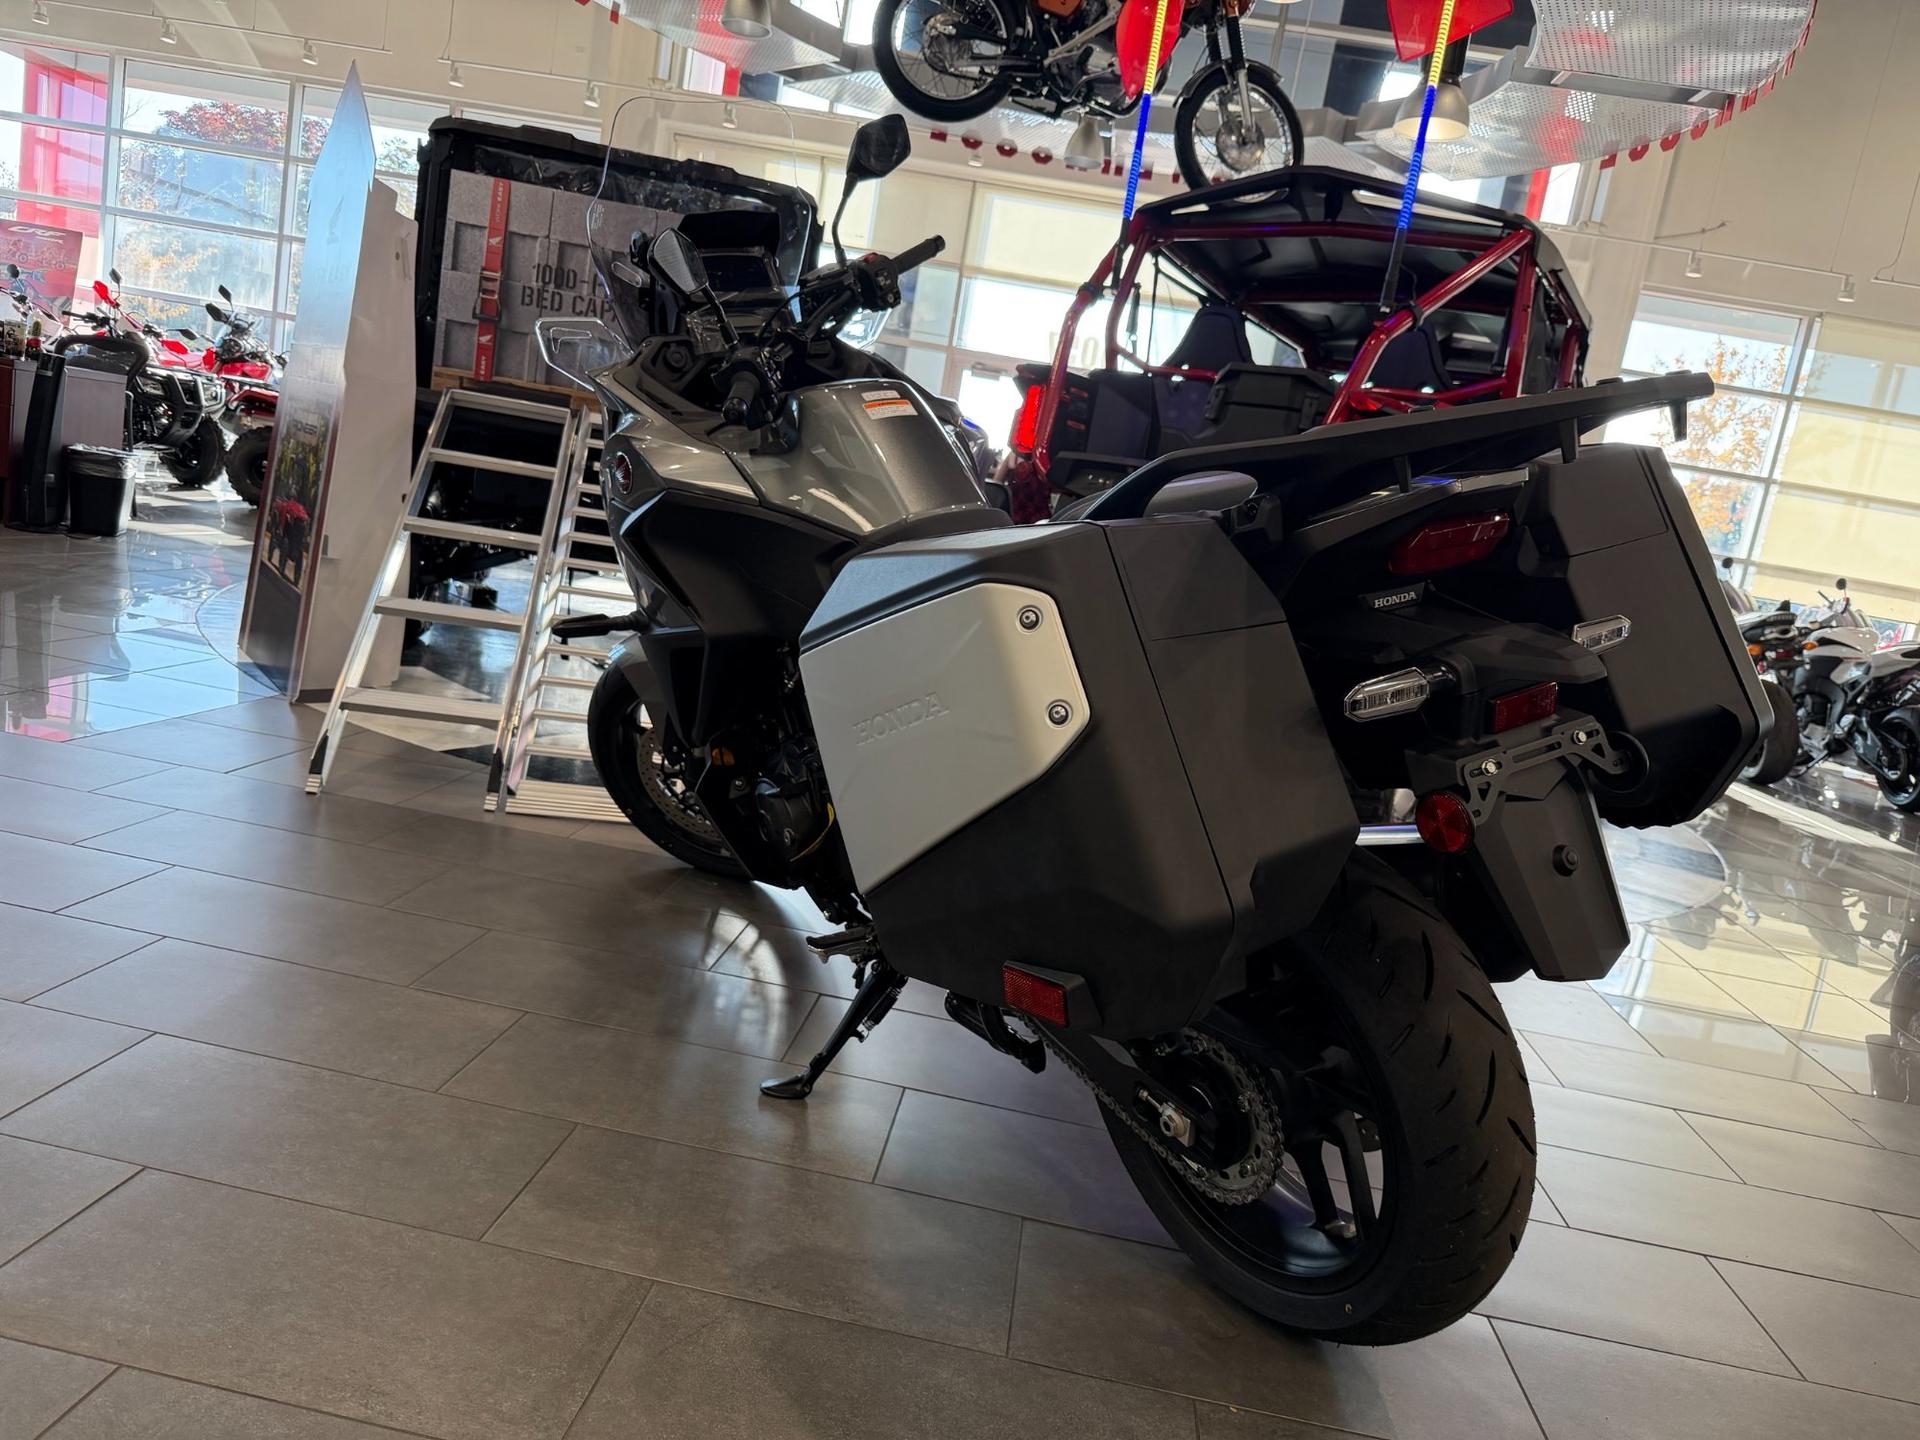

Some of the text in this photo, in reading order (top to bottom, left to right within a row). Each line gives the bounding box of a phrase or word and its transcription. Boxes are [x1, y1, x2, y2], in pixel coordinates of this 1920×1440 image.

[521, 285, 563, 312] BED
[1374, 591, 1418, 608] HONDA
[851, 691, 949, 746] HONDA
